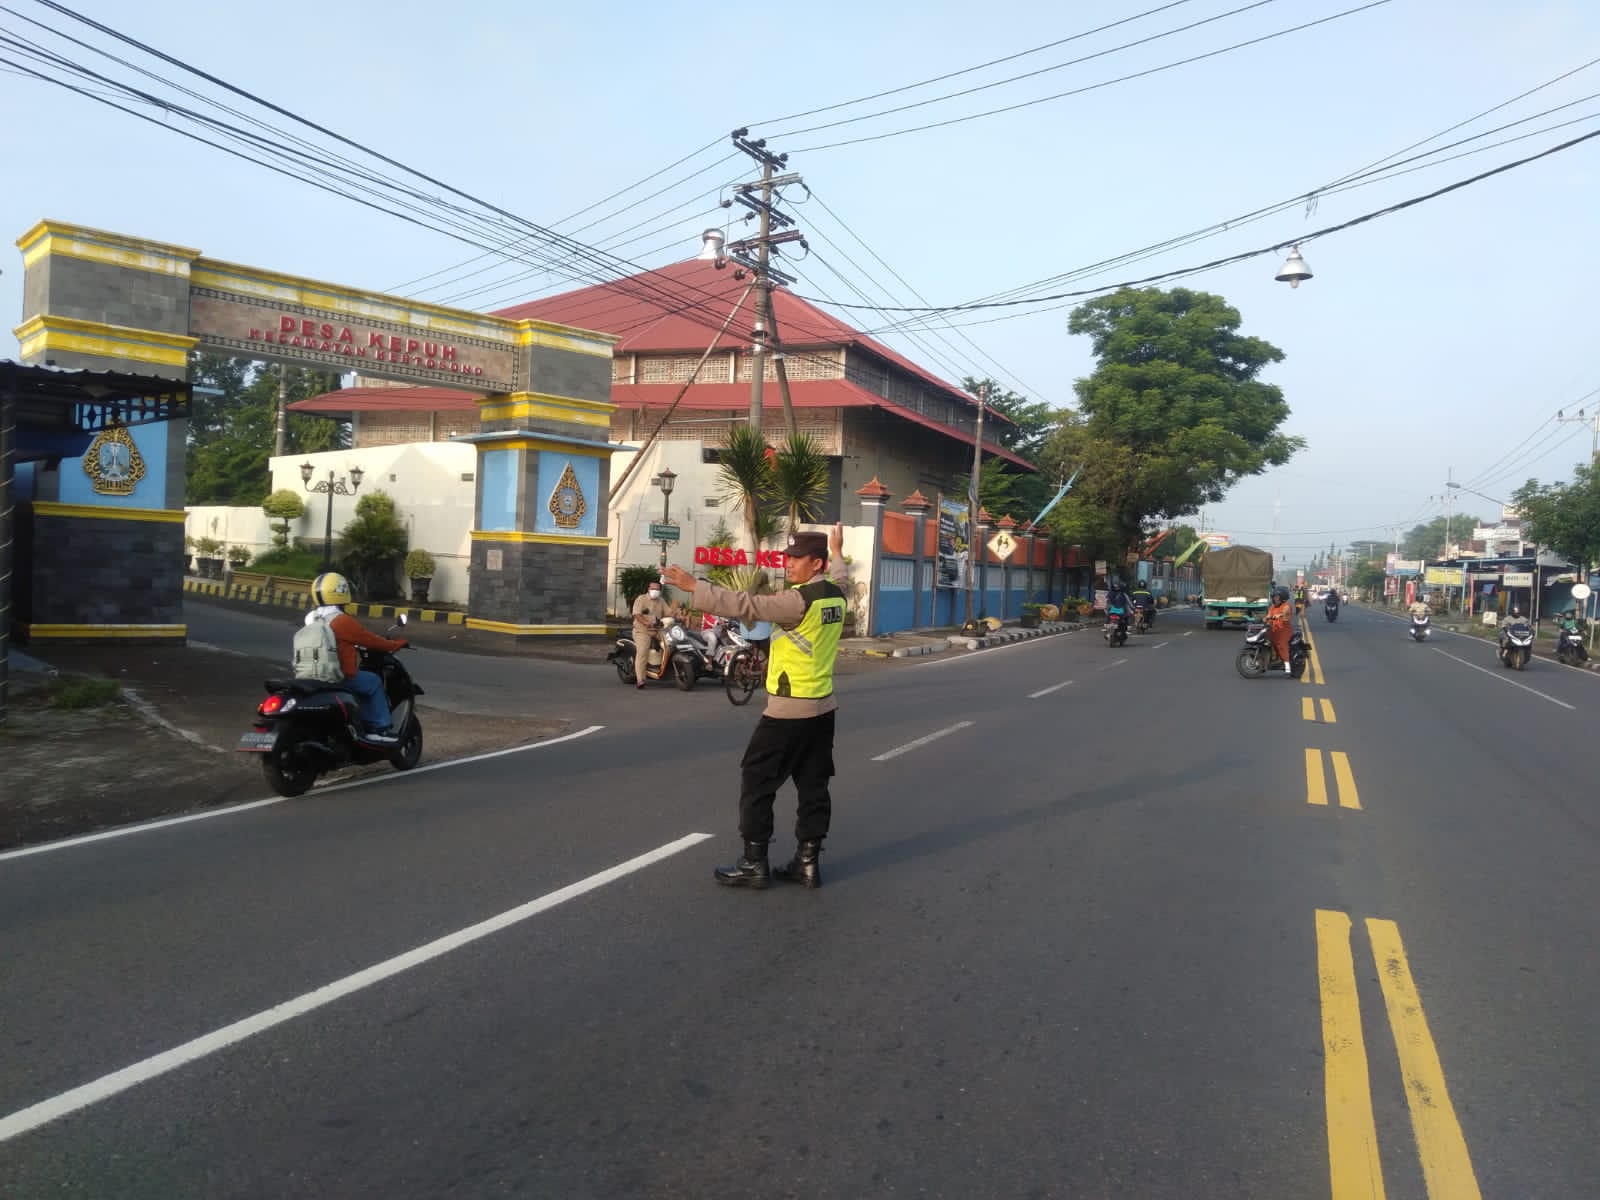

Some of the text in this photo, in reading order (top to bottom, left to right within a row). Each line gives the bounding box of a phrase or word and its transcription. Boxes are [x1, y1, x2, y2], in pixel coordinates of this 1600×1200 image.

[248, 328, 366, 357] KECAMATAN
[280, 315, 456, 361] DESA KEPUH
[694, 546, 748, 566] DESA
